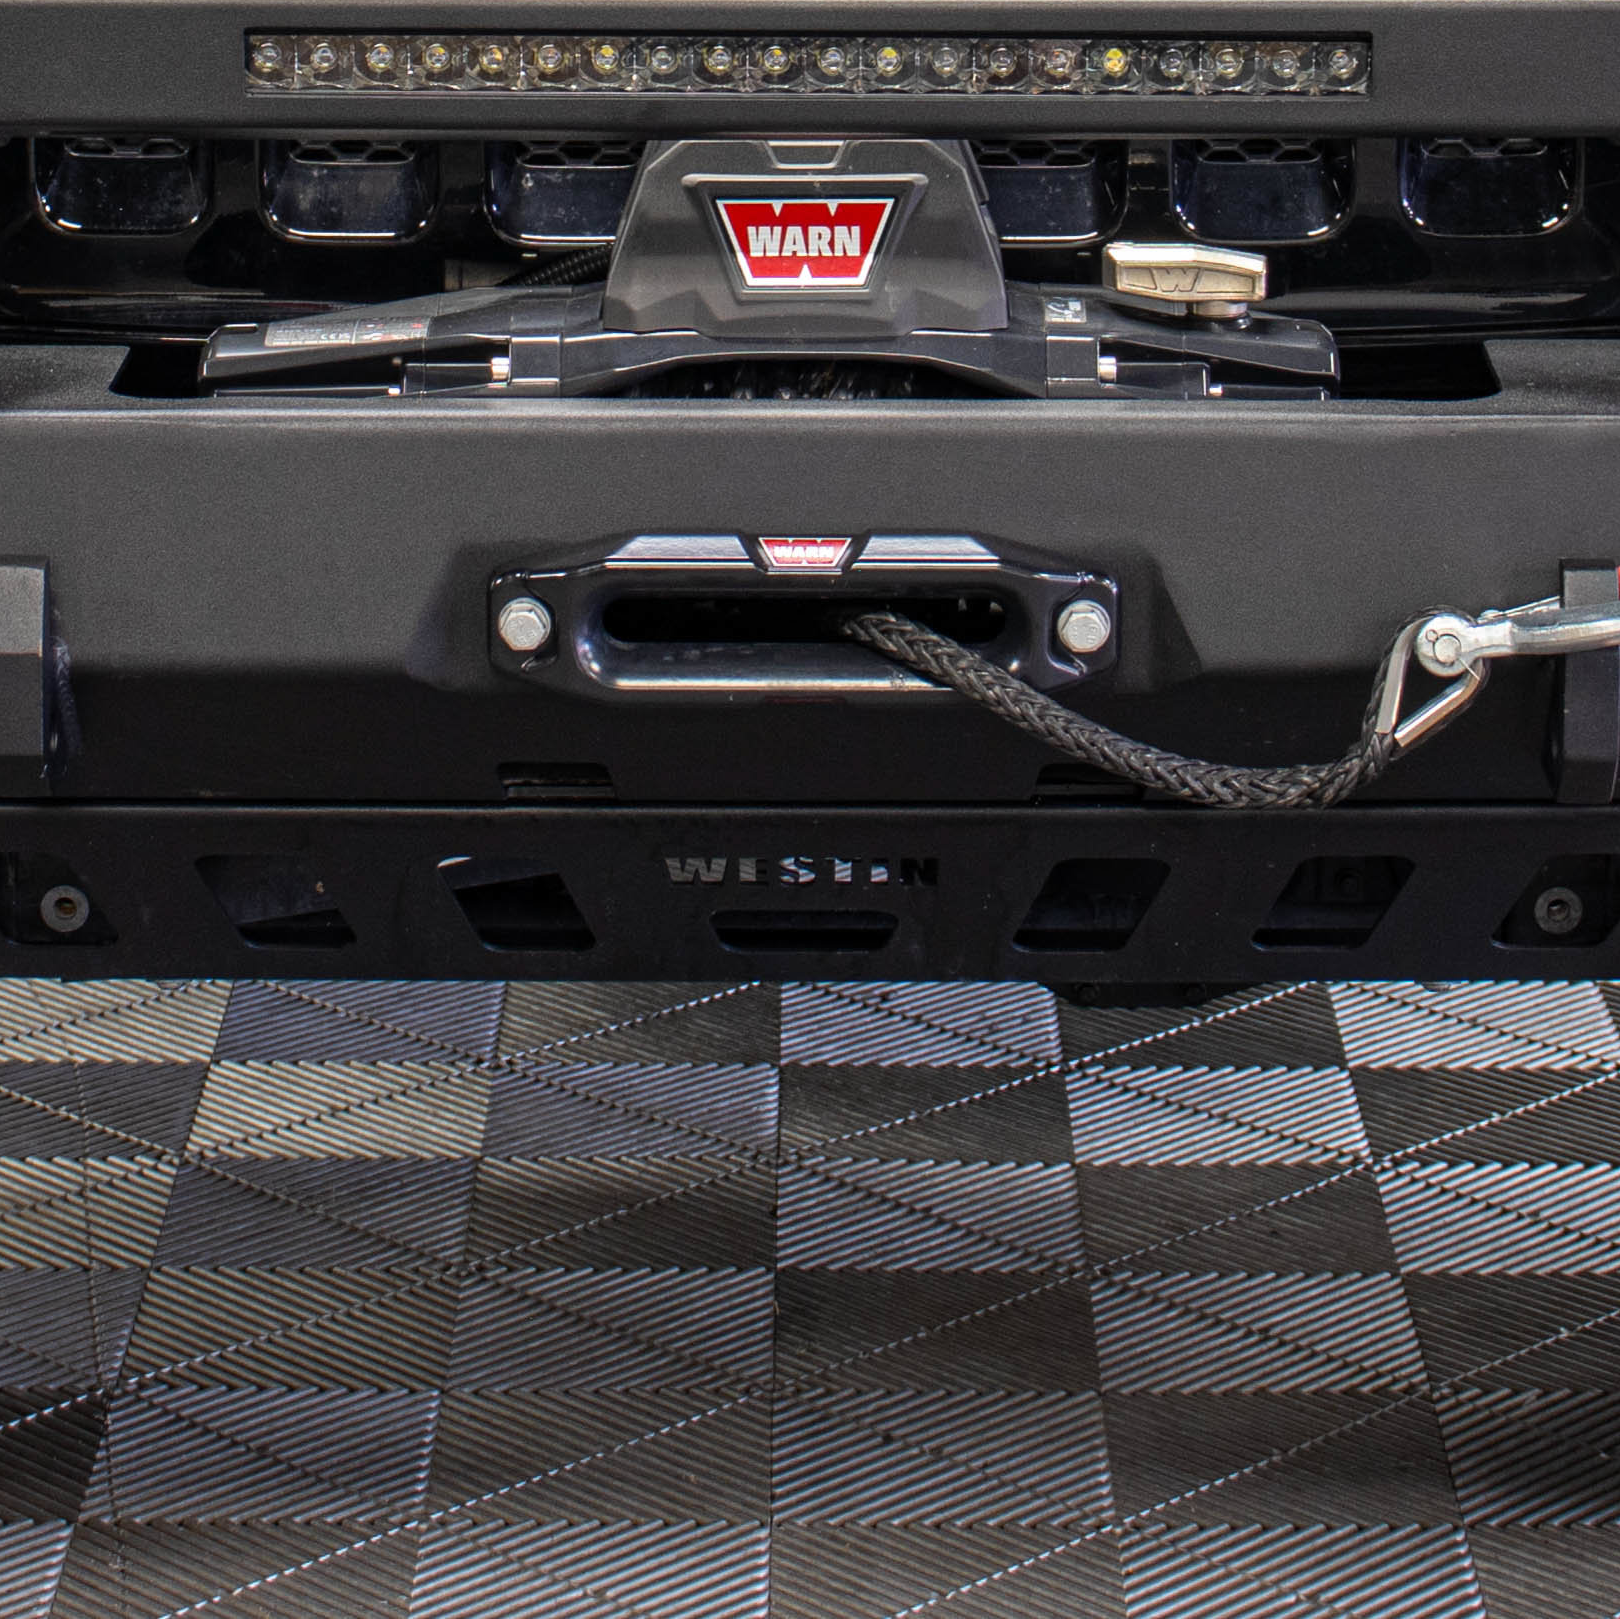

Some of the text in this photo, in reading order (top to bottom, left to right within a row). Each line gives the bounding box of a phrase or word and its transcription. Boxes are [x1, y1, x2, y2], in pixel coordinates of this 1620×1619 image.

[746, 225, 862, 257] WARN
[772, 545, 835, 558] WARN
[663, 855, 940, 886] WESTIN
